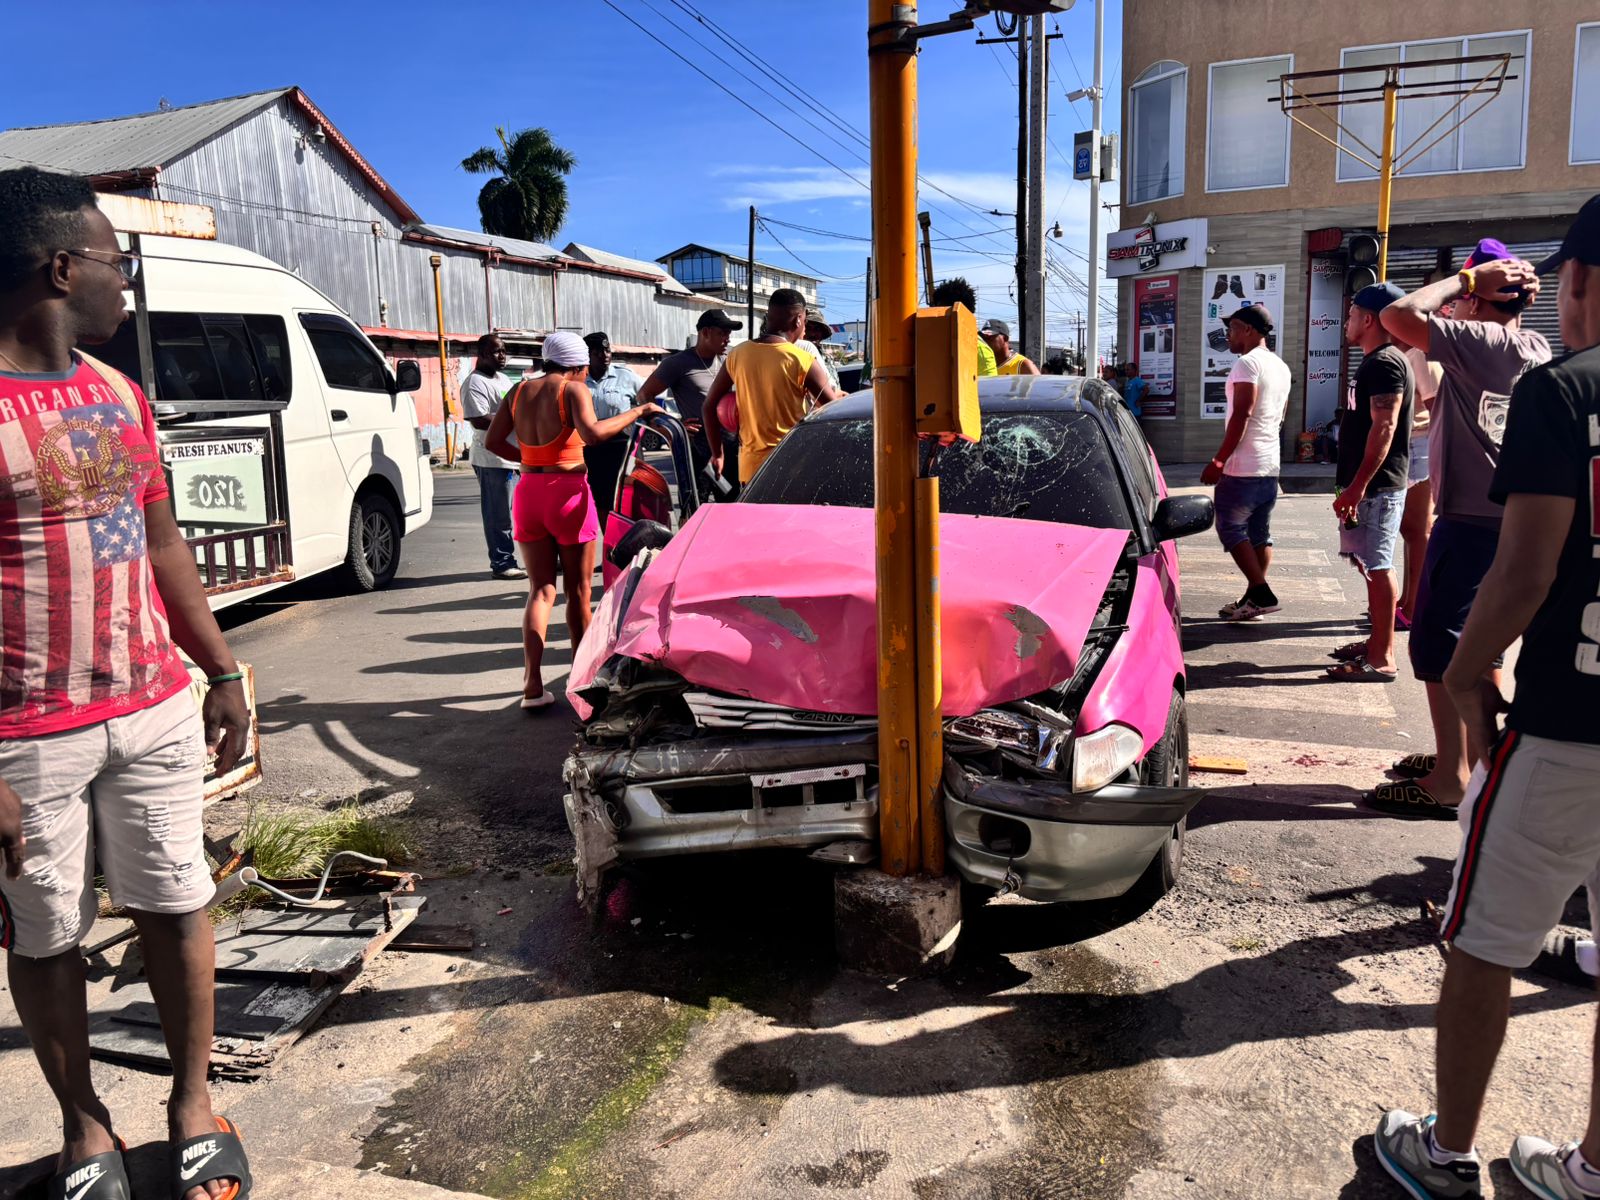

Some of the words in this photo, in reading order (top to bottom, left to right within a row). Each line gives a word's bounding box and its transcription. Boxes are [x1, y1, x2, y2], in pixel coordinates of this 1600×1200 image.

[1109, 237, 1188, 260] SAMTRONIX
[1309, 350, 1340, 358] WELCOME
[171, 445, 206, 459] FRESH
[208, 442, 253, 456] PEANUTS
[792, 711, 856, 723] CARINA
[1376, 786, 1437, 805] AIR
[182, 1139, 217, 1164] NIKE
[65, 1162, 101, 1192] NIKE
